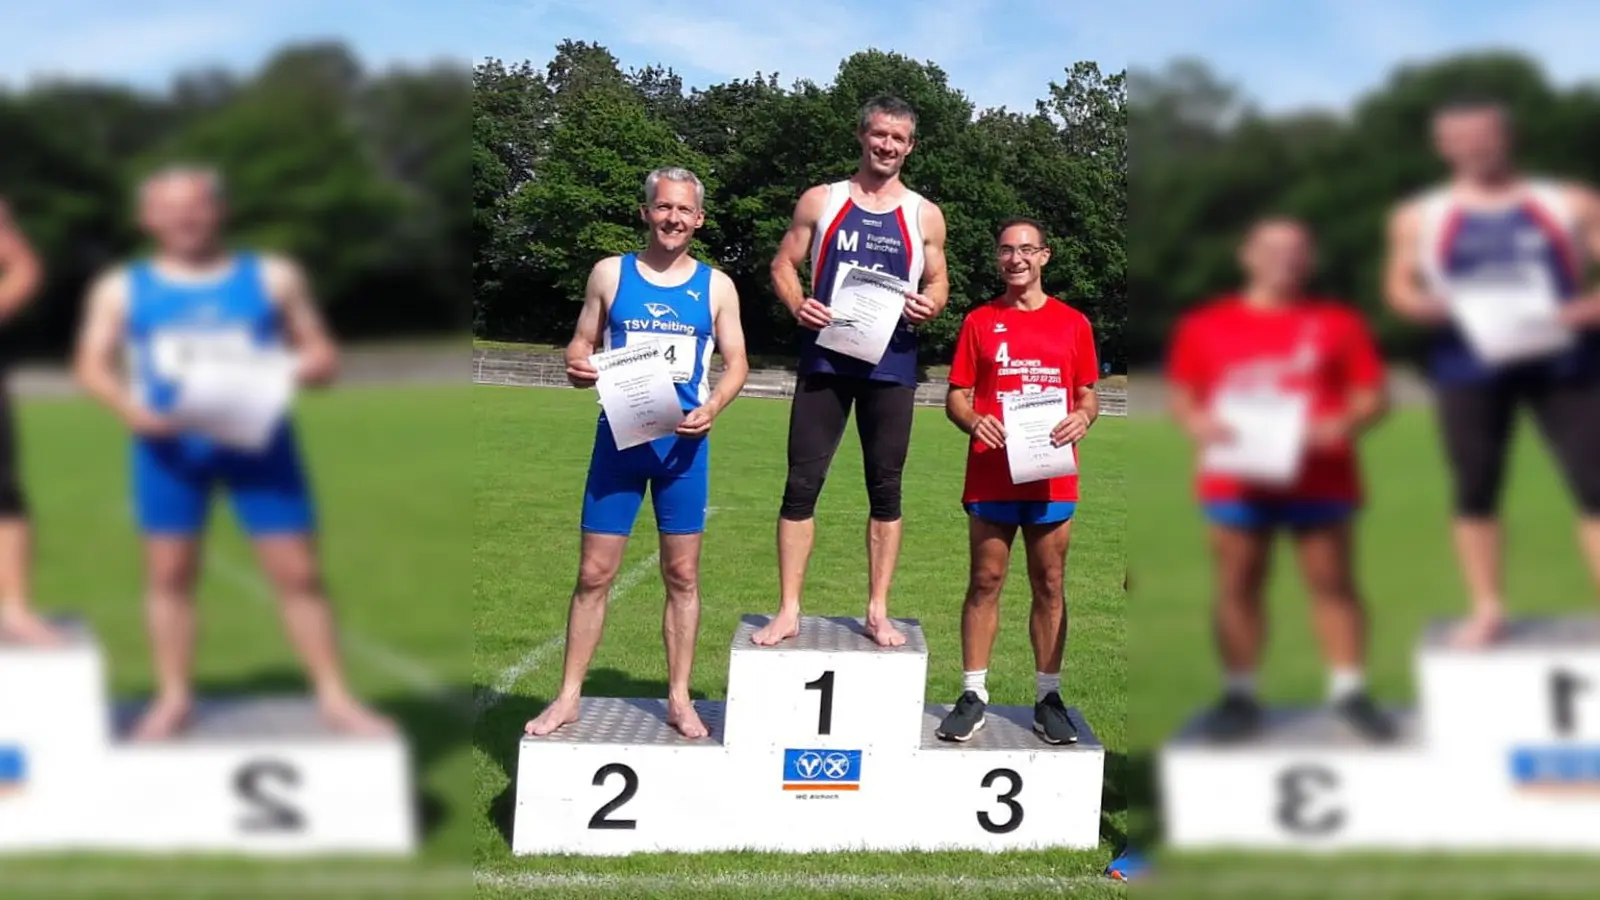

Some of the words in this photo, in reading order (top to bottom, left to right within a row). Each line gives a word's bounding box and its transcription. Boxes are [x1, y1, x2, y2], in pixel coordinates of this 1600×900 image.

[837, 229, 859, 252] M
[867, 233, 901, 246] Flughafen
[624, 319, 650, 330] TSV
[652, 320, 696, 337] Peiting
[663, 344, 677, 365] 4
[995, 341, 1011, 368] 4
[804, 670, 836, 736] 1
[587, 762, 640, 830] 2
[976, 768, 1025, 834] 3
